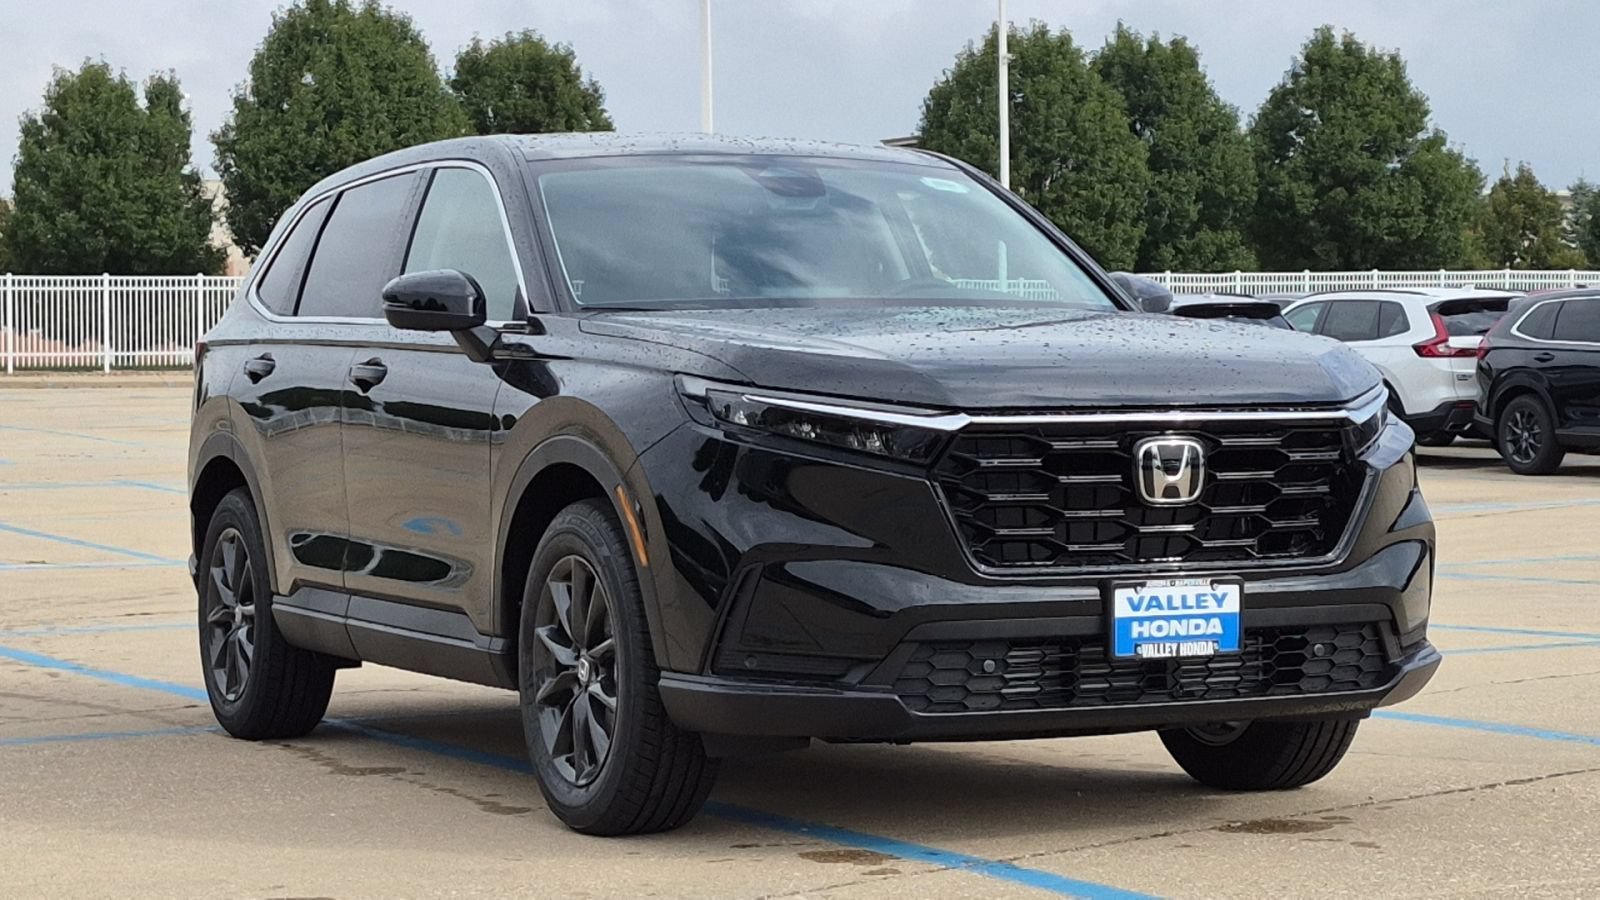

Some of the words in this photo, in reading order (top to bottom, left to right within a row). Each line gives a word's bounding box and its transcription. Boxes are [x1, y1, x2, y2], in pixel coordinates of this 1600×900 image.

[1126, 592, 1229, 612] VALLEY
[1131, 617, 1224, 639] HONDA
[1142, 642, 1178, 658] VALLEY
[1179, 641, 1215, 657] HONDA
